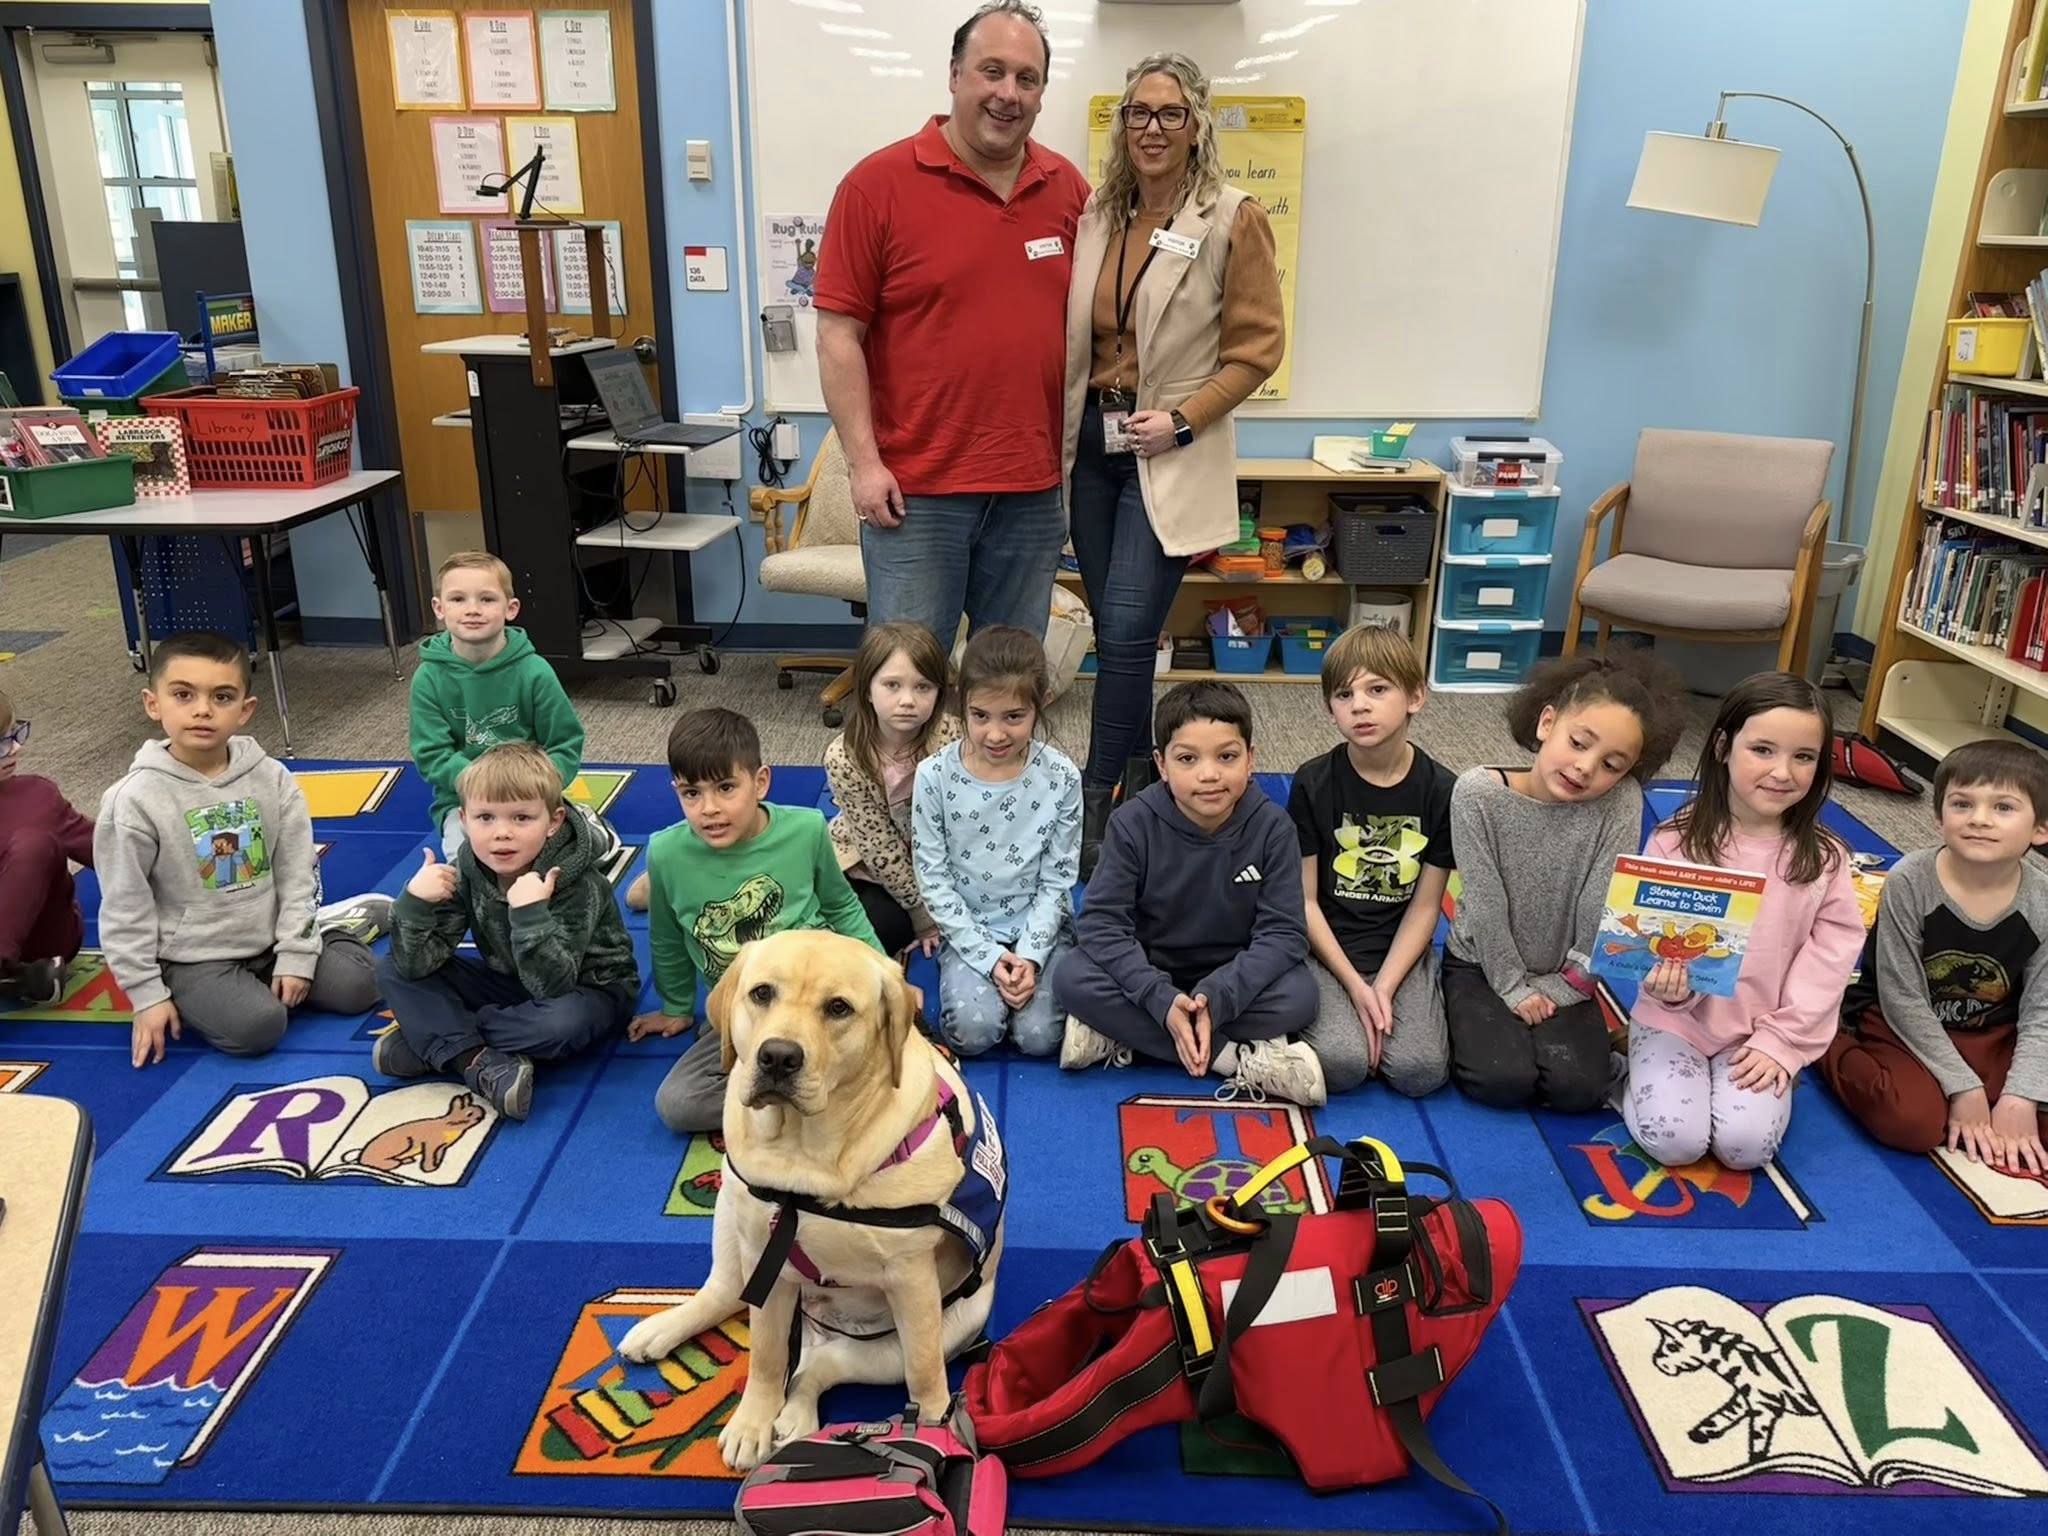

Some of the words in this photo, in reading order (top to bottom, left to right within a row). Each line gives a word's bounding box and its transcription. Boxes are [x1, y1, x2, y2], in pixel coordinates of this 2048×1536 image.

[1247, 160, 1276, 179] learn
[772, 223, 796, 237] Rug
[799, 223, 825, 235] Rule
[210, 311, 252, 335] MAKER
[195, 416, 255, 440] Library
[1947, 524, 1968, 539] SKY
[1624, 862, 1639, 871] This
[1658, 868, 1678, 878] could
[1334, 889, 1370, 901] UNDER
[1640, 894, 1676, 909] Learns
[1679, 900, 1690, 910] to
[1692, 902, 1722, 914] Swim
[1649, 885, 1682, 899] Stewie
[1692, 892, 1718, 904] Duck
[188, 1087, 345, 1164] R
[1175, 1110, 1273, 1163] T
[126, 1285, 295, 1388] W
[1786, 1313, 1980, 1459] Z
